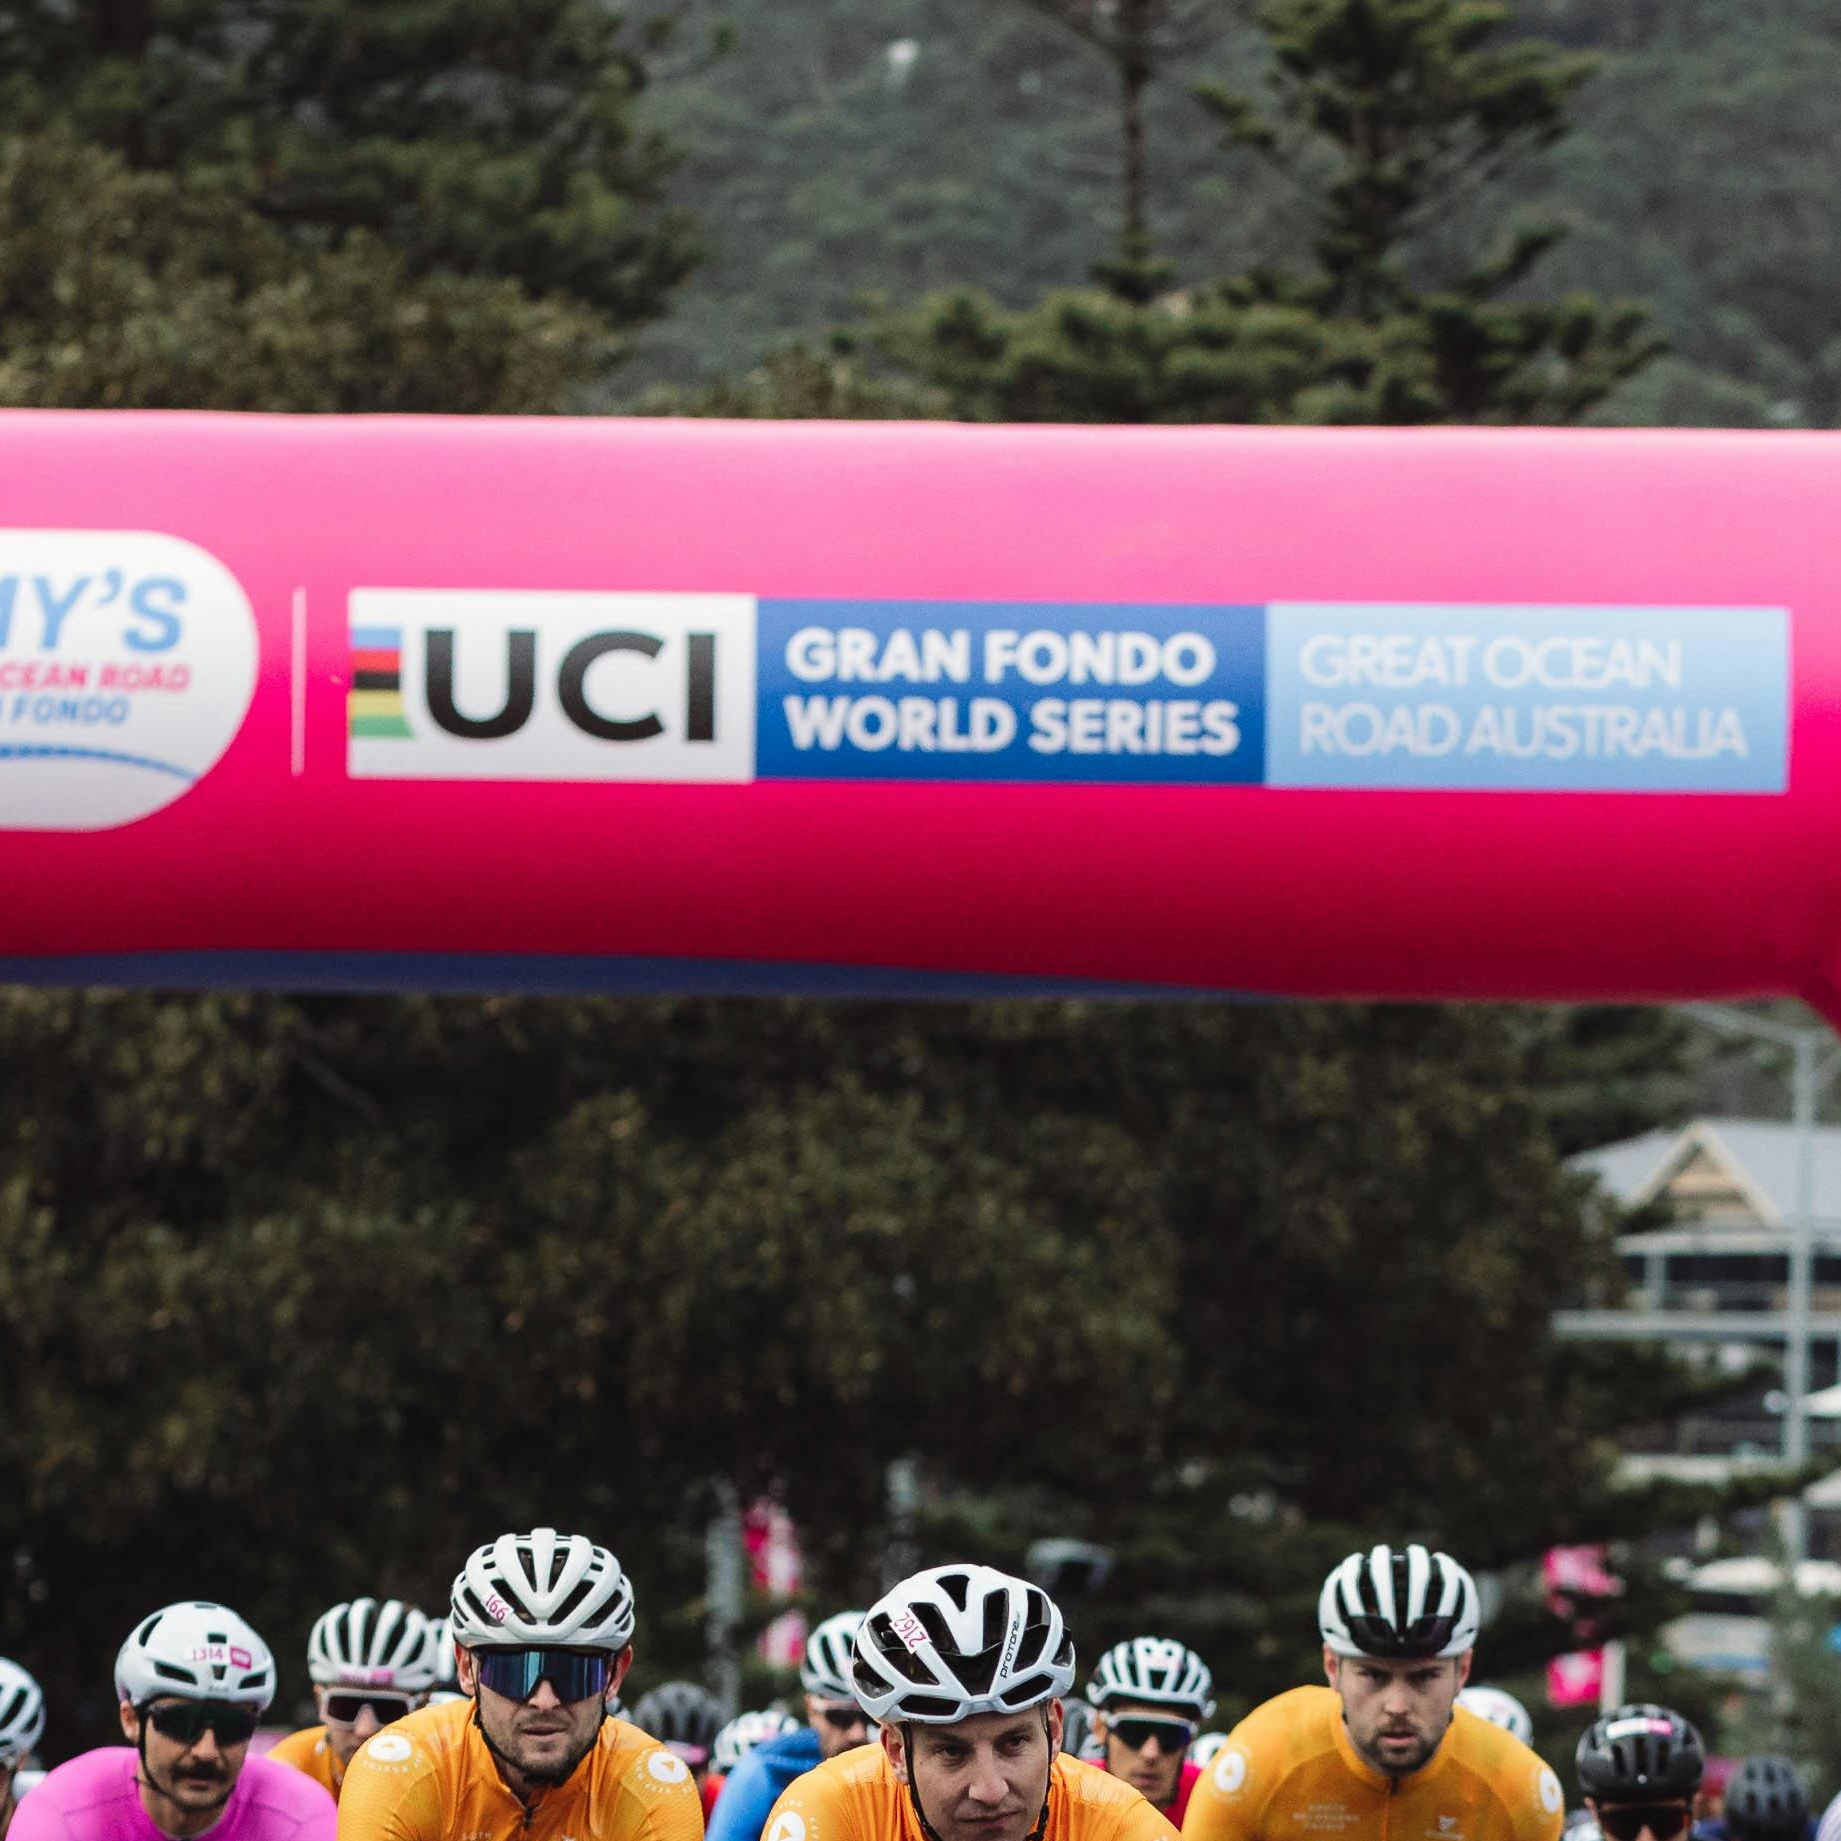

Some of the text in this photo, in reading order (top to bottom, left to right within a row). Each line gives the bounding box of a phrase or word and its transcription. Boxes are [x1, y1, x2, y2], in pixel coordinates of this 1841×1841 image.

[100, 661, 189, 692] ROAD
[785, 629, 1215, 686] GRAN FONDO
[1299, 634, 1681, 690] GREAT OCEAN
[11, 695, 129, 726] FONDO
[420, 629, 715, 744] UCI
[784, 698, 1241, 755] WORLD SERIES
[1299, 702, 1750, 760] ROAD AUSTRALIA
